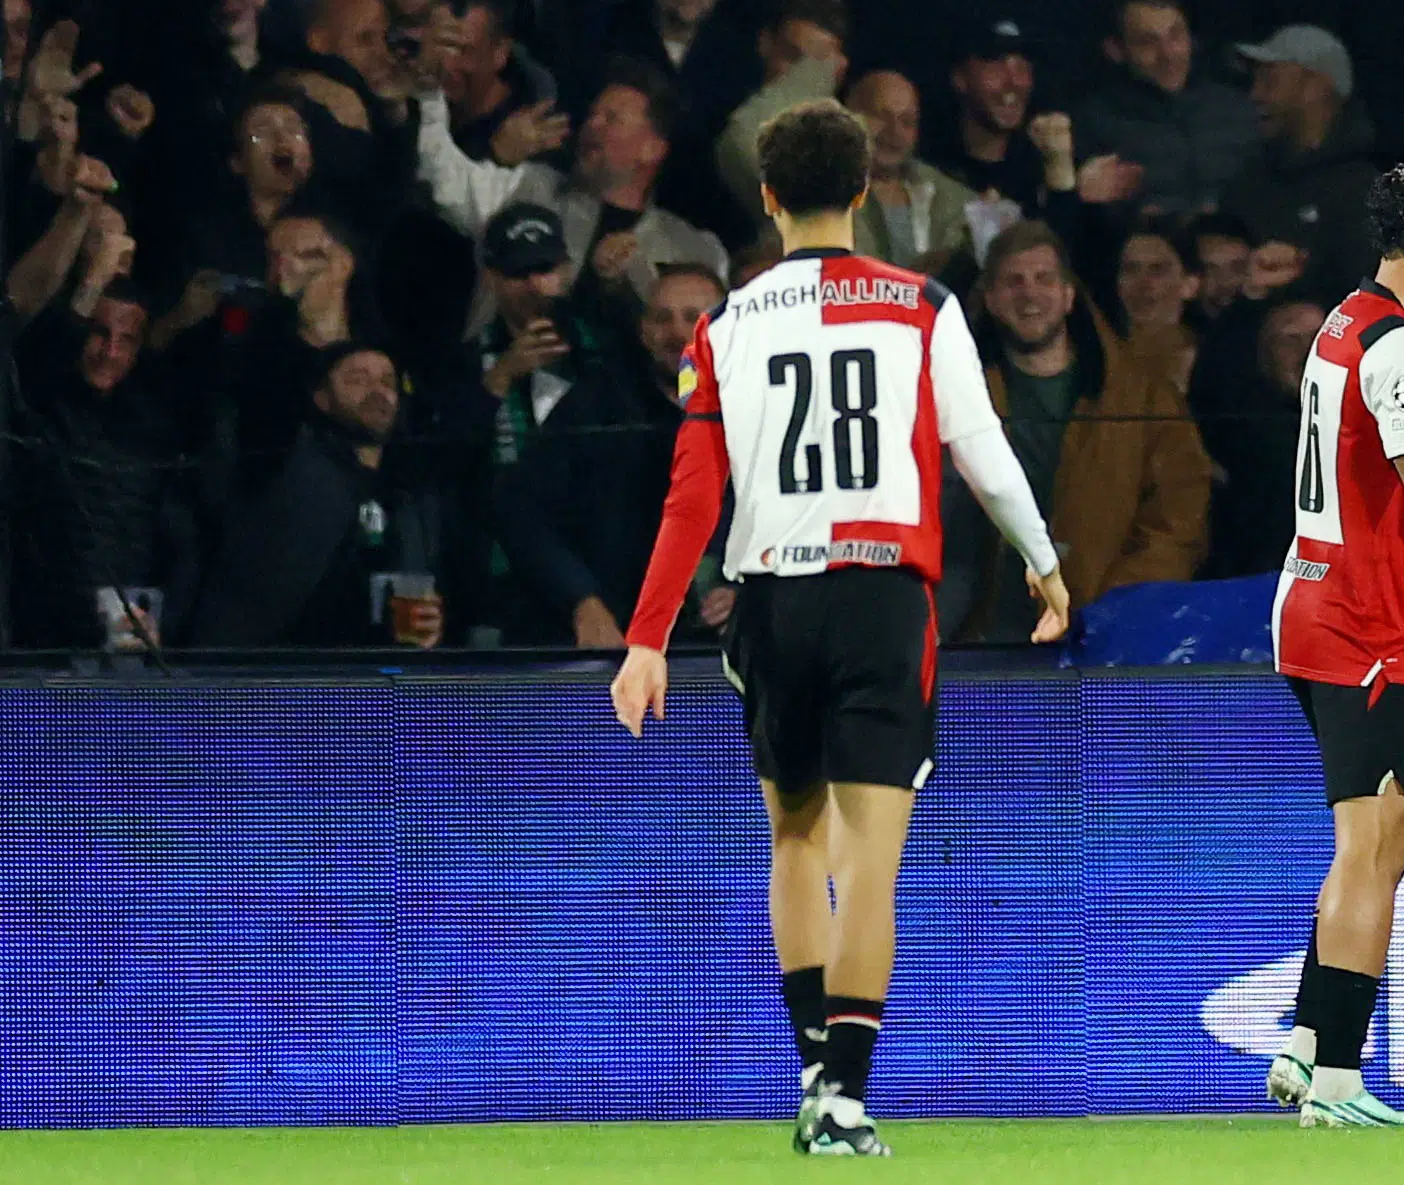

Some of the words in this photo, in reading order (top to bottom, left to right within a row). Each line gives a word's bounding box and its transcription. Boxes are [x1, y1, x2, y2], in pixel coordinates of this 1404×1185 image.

[731, 278, 919, 320] TARGHALLINE
[768, 348, 880, 495] 28
[782, 542, 900, 565] FOUNATION
